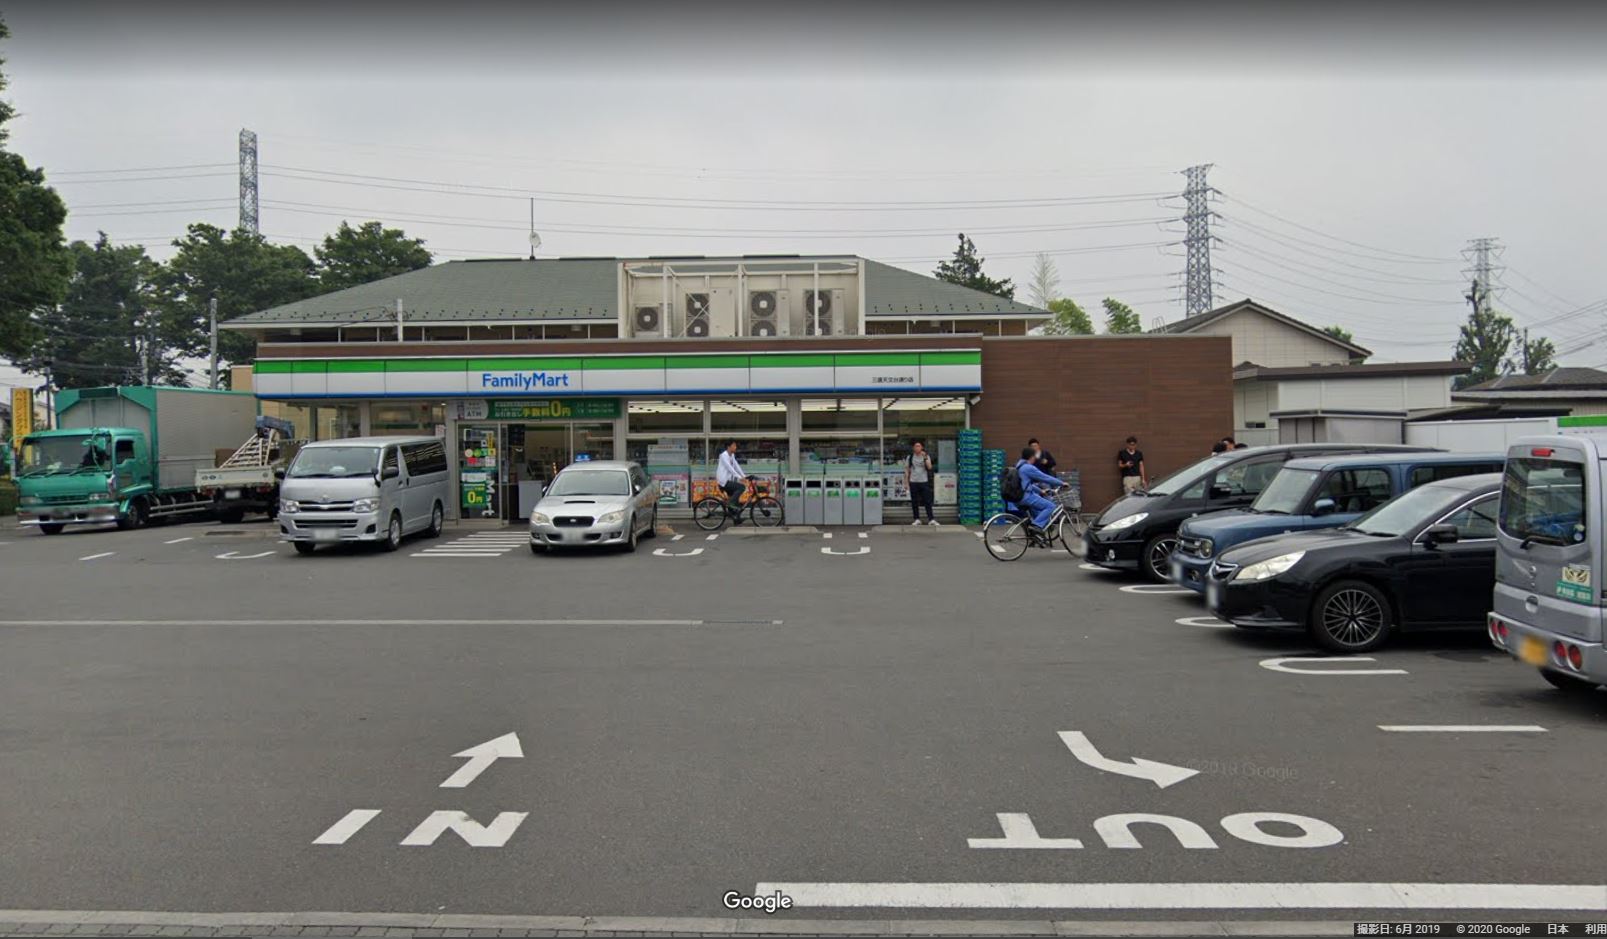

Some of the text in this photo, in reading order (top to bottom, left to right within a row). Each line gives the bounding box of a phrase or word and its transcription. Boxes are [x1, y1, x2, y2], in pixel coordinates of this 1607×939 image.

[482, 372, 569, 391] FamilyMart
[311, 809, 530, 847] IN
[967, 812, 1345, 849] OUT
